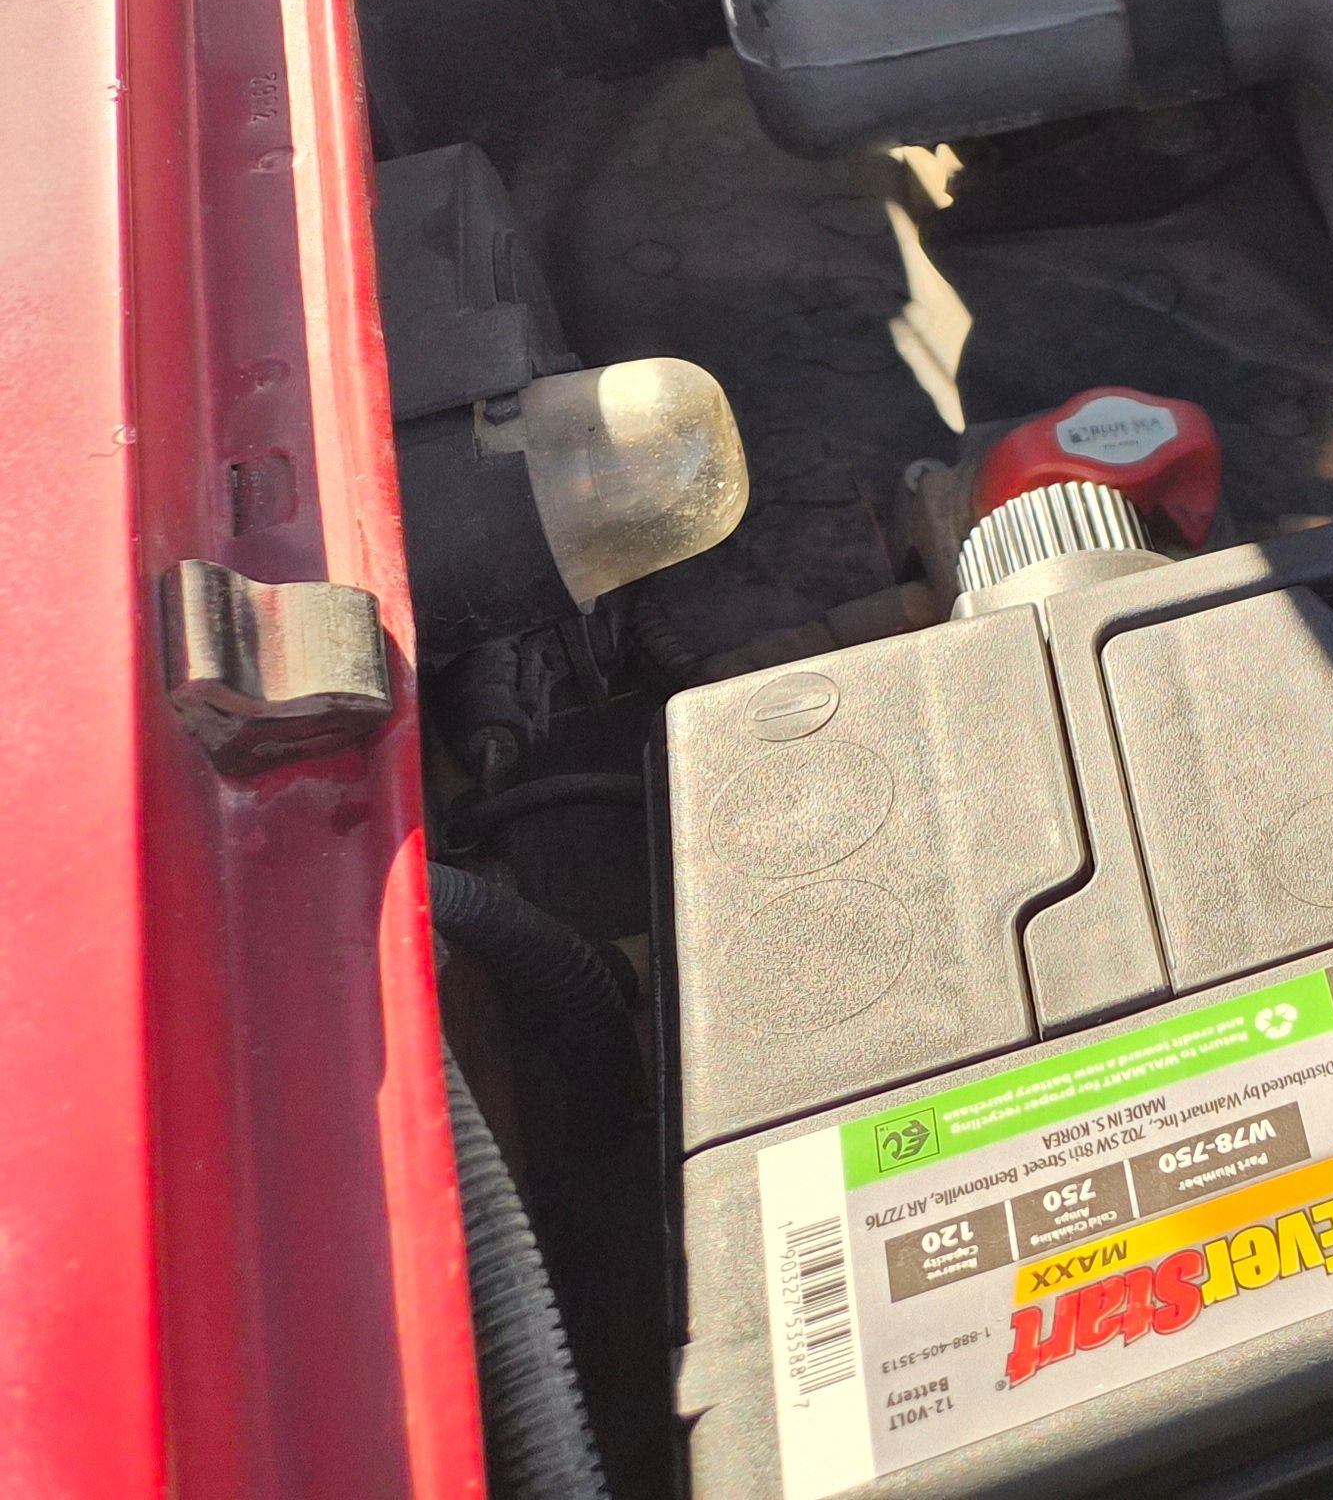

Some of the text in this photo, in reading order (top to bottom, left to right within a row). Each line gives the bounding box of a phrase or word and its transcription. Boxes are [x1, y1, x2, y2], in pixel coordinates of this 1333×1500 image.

[942, 1016, 1245, 1122] and credit toward a new battery purchase
[949, 1030, 1249, 1134] Return to WALMART for proper recycling
[1179, 1092, 1242, 1124] Walmart
[1243, 1084, 1261, 1101] by
[1041, 1096, 1166, 1150] MADE IN S. KOREA
[1120, 1124, 1146, 1145] 702
[1149, 1113, 1179, 1130] Inc.,
[1096, 1132, 1120, 1154] SW
[1158, 1118, 1277, 1174] W78-750
[1022, 1150, 1067, 1177] Street
[1178, 1152, 1269, 1191] Part Number
[930, 1167, 1019, 1206] Bentonville,
[1042, 1178, 1097, 1213] 750
[865, 1204, 906, 1231] 72716
[907, 1197, 927, 1217] AR
[1054, 1206, 1090, 1225] Amps
[921, 1220, 974, 1254] 120
[1030, 1210, 1118, 1246] Cold Cranking
[922, 1244, 979, 1269] Capacity
[926, 1257, 978, 1281] Reserve
[1030, 1240, 1127, 1293] MAXX
[777, 1246, 801, 1309] 90327
[783, 1314, 809, 1380] 53588
[881, 1327, 991, 1375] 1-888-405-3513
[886, 1376, 950, 1408] Battery
[889, 1395, 954, 1432] 12-VOLT
